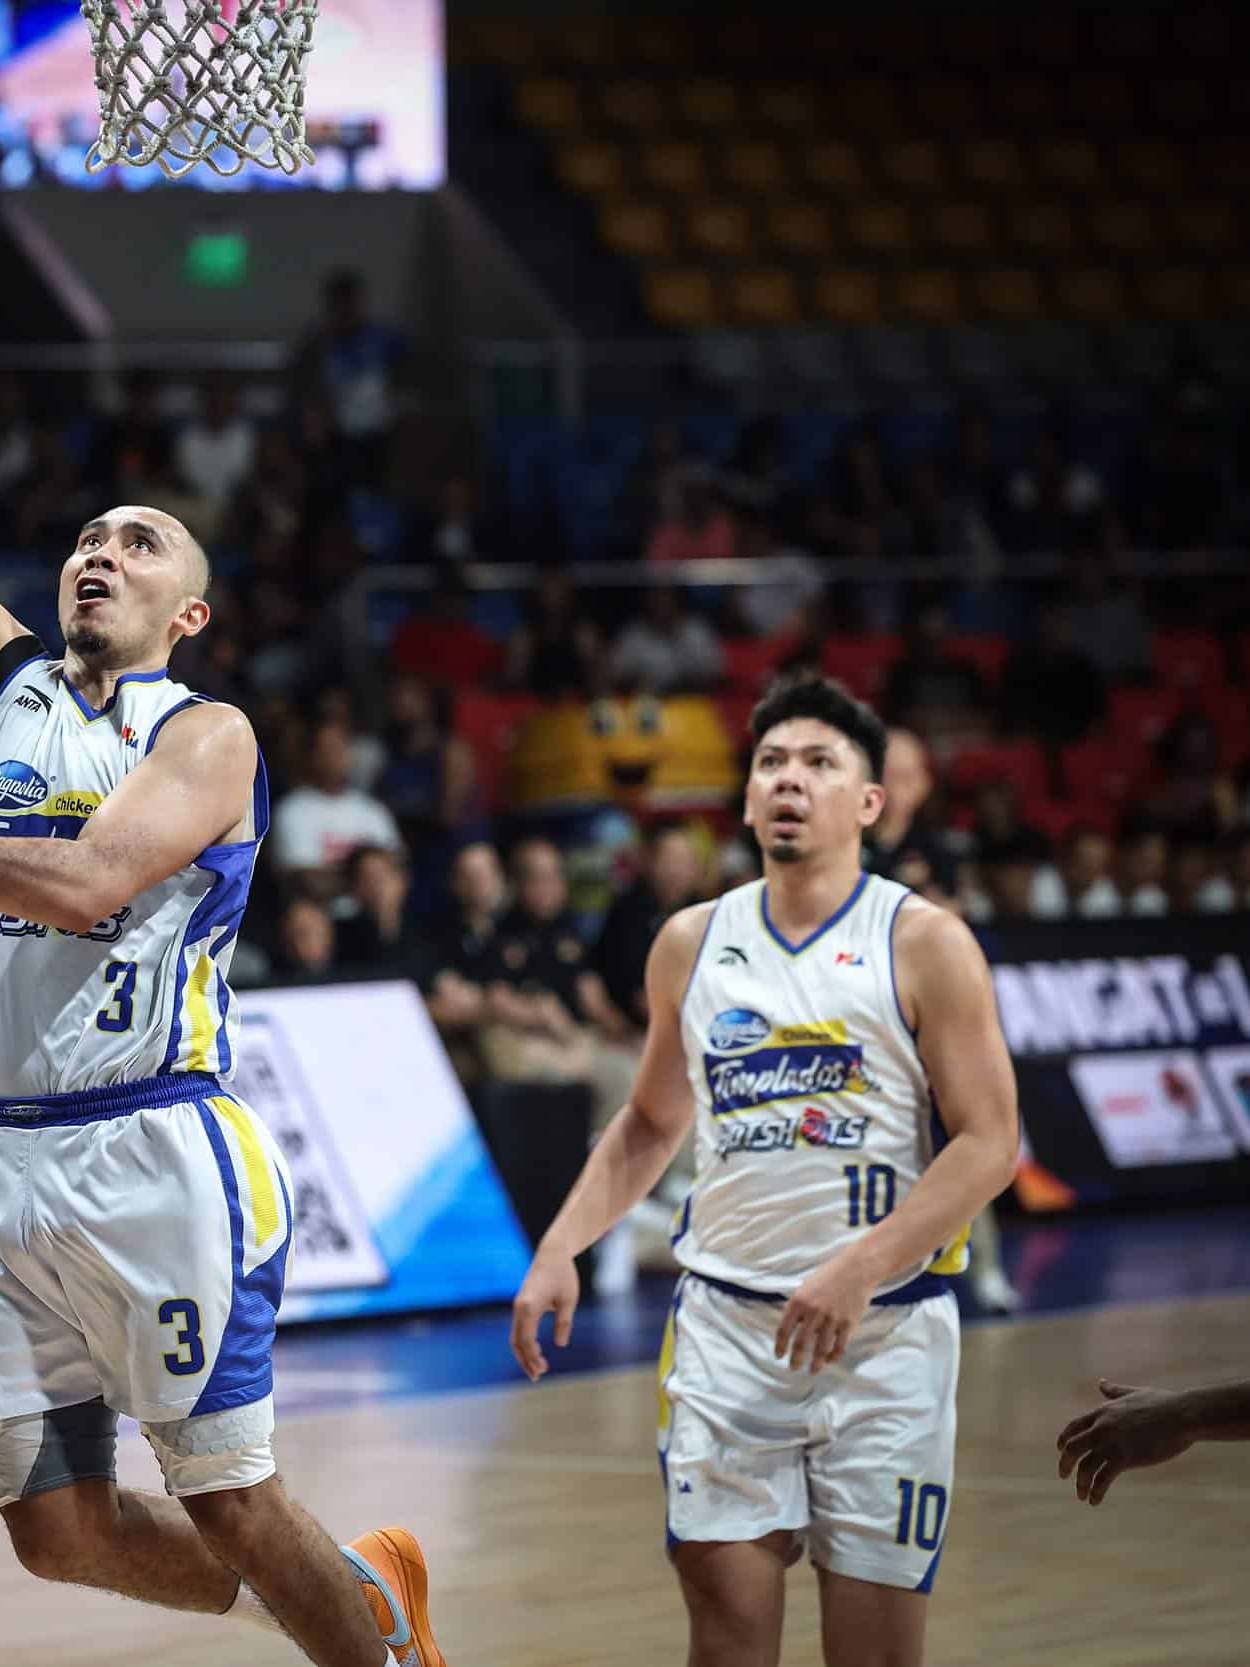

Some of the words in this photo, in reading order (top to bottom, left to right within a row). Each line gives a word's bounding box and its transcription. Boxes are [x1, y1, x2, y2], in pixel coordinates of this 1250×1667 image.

[13, 694, 42, 713] ANTA
[97, 961, 137, 1033] 3
[843, 1165, 895, 1227] 10
[158, 1298, 206, 1376] 3
[895, 1477, 948, 1552] 10
